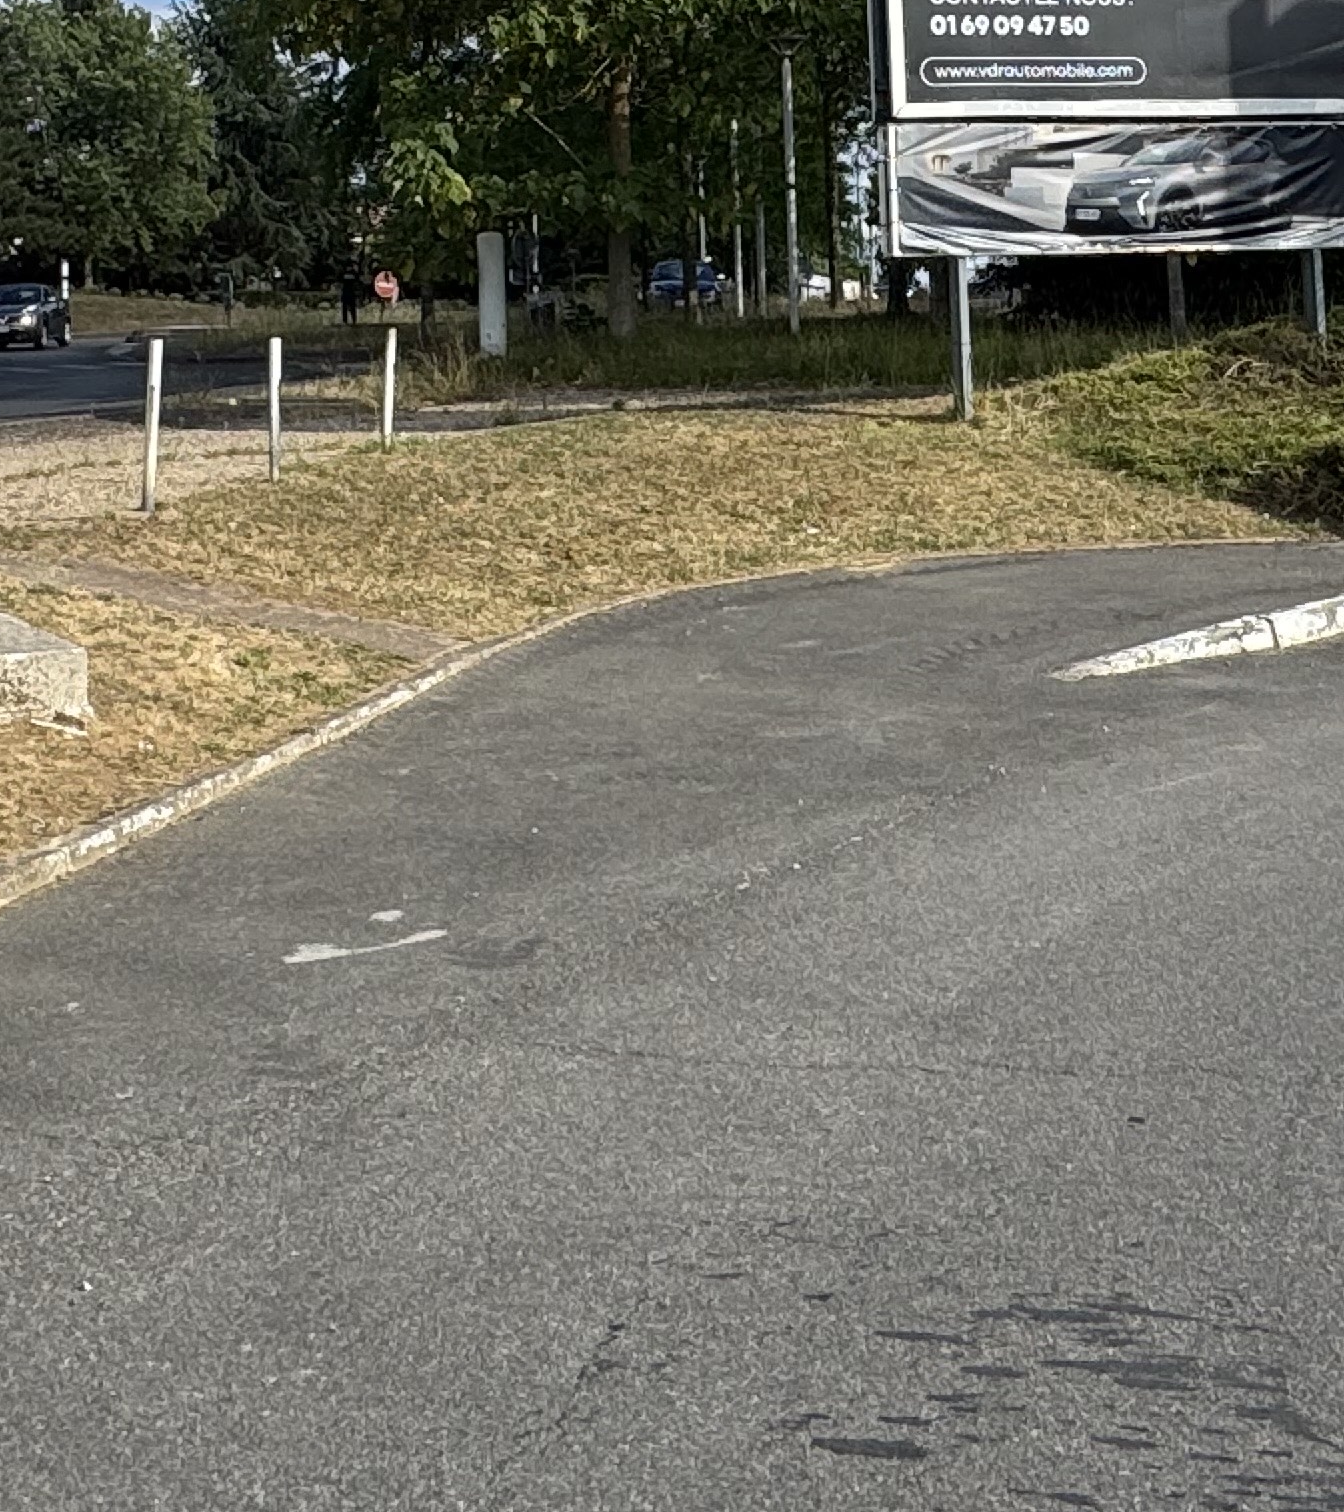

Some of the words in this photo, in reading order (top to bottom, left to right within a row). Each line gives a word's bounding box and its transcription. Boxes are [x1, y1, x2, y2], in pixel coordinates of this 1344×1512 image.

[929, 14, 957, 36] 01
[960, 14, 990, 36] 69
[993, 14, 1024, 36] 09
[1027, 15, 1057, 36] 47
[1060, 15, 1090, 36] 50
[933, 62, 1134, 79] www.vdrautomobile.com
